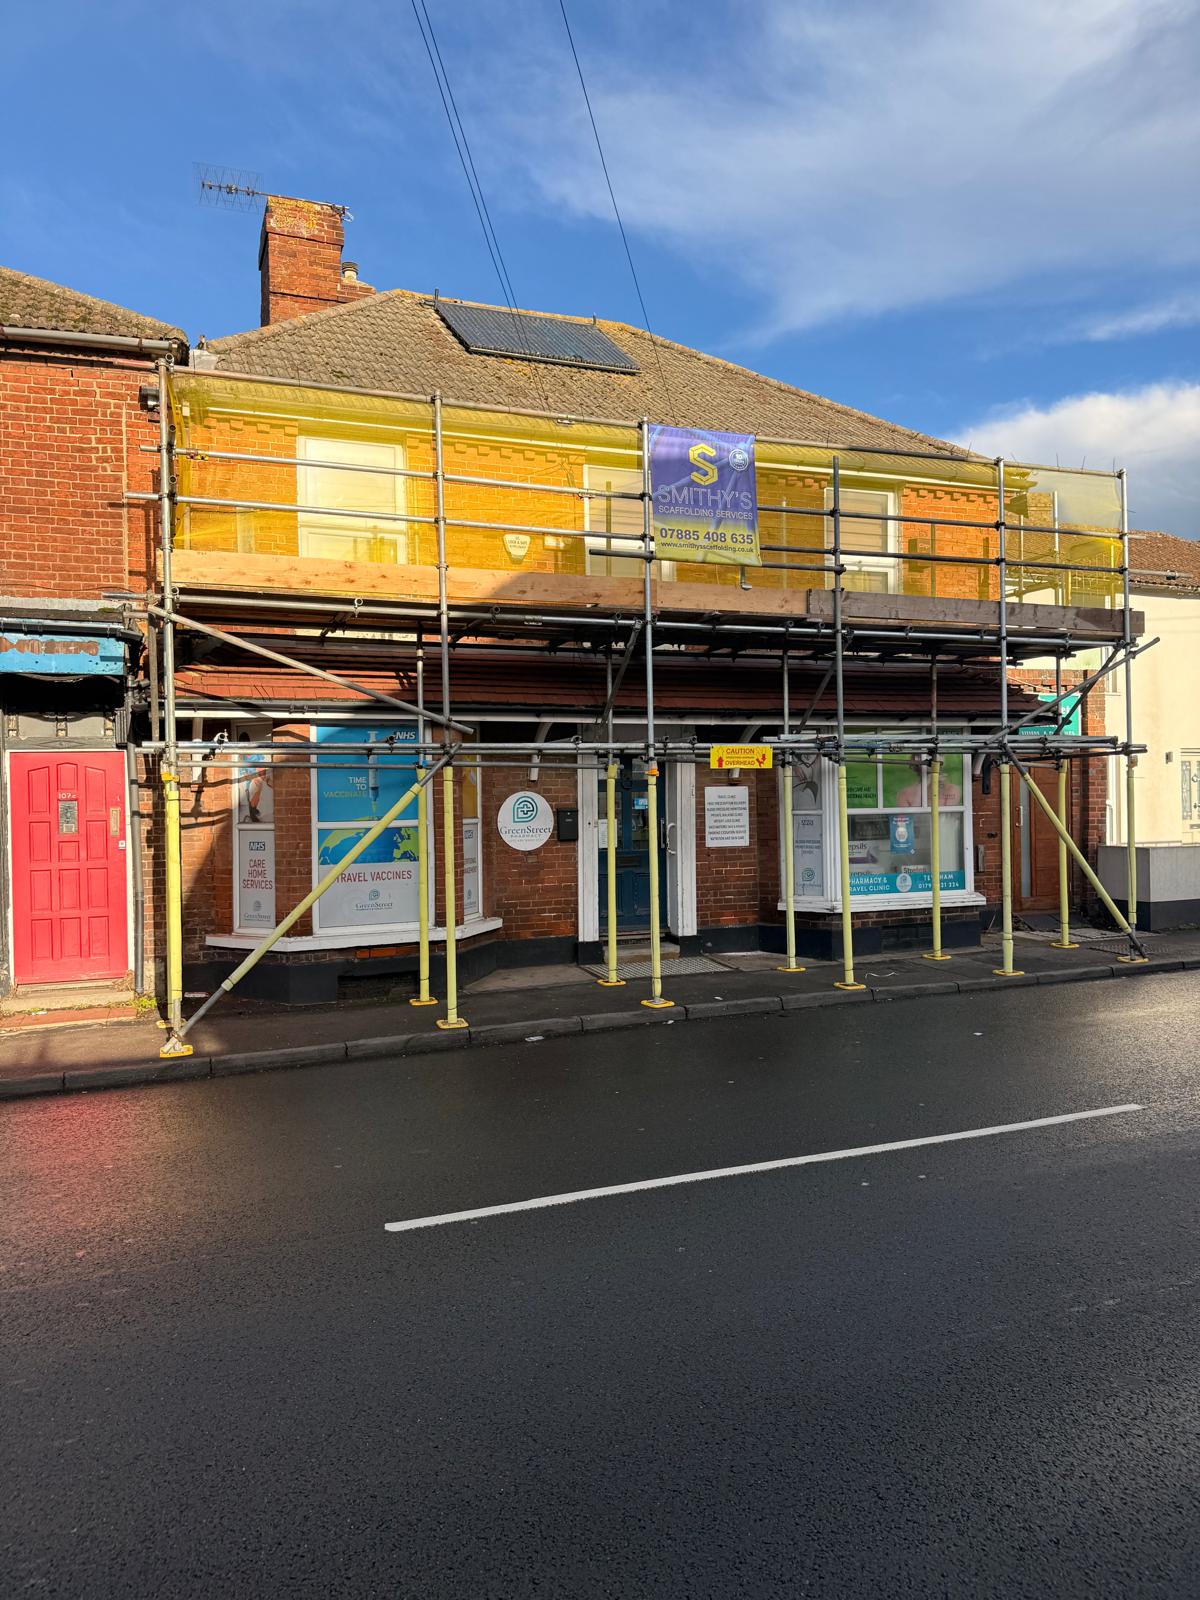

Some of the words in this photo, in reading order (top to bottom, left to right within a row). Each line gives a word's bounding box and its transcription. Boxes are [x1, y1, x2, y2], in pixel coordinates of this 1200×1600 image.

[657, 484, 753, 510] SMITHY'S
[658, 505, 714, 518] SCAFFOLDING
[715, 510, 753, 520] SERVICES
[660, 527, 700, 541] 07885
[703, 531, 727, 543] 408
[730, 533, 754, 545] 635
[660, 541, 754, 553] www.smithysscaffolding.co.uk
[395, 731, 416, 740] NHS
[347, 776, 367, 784] TIME
[356, 783, 367, 791] TO
[500, 825, 552, 835] GreenStreet
[248, 841, 266, 851] NHS
[248, 859, 267, 869] CARE
[247, 869, 267, 879] HOME
[335, 872, 368, 883] TRAVEL
[370, 870, 412, 882] VACCINES
[242, 879, 274, 890] SERVICES
[868, 884, 890, 892] CLINIC
